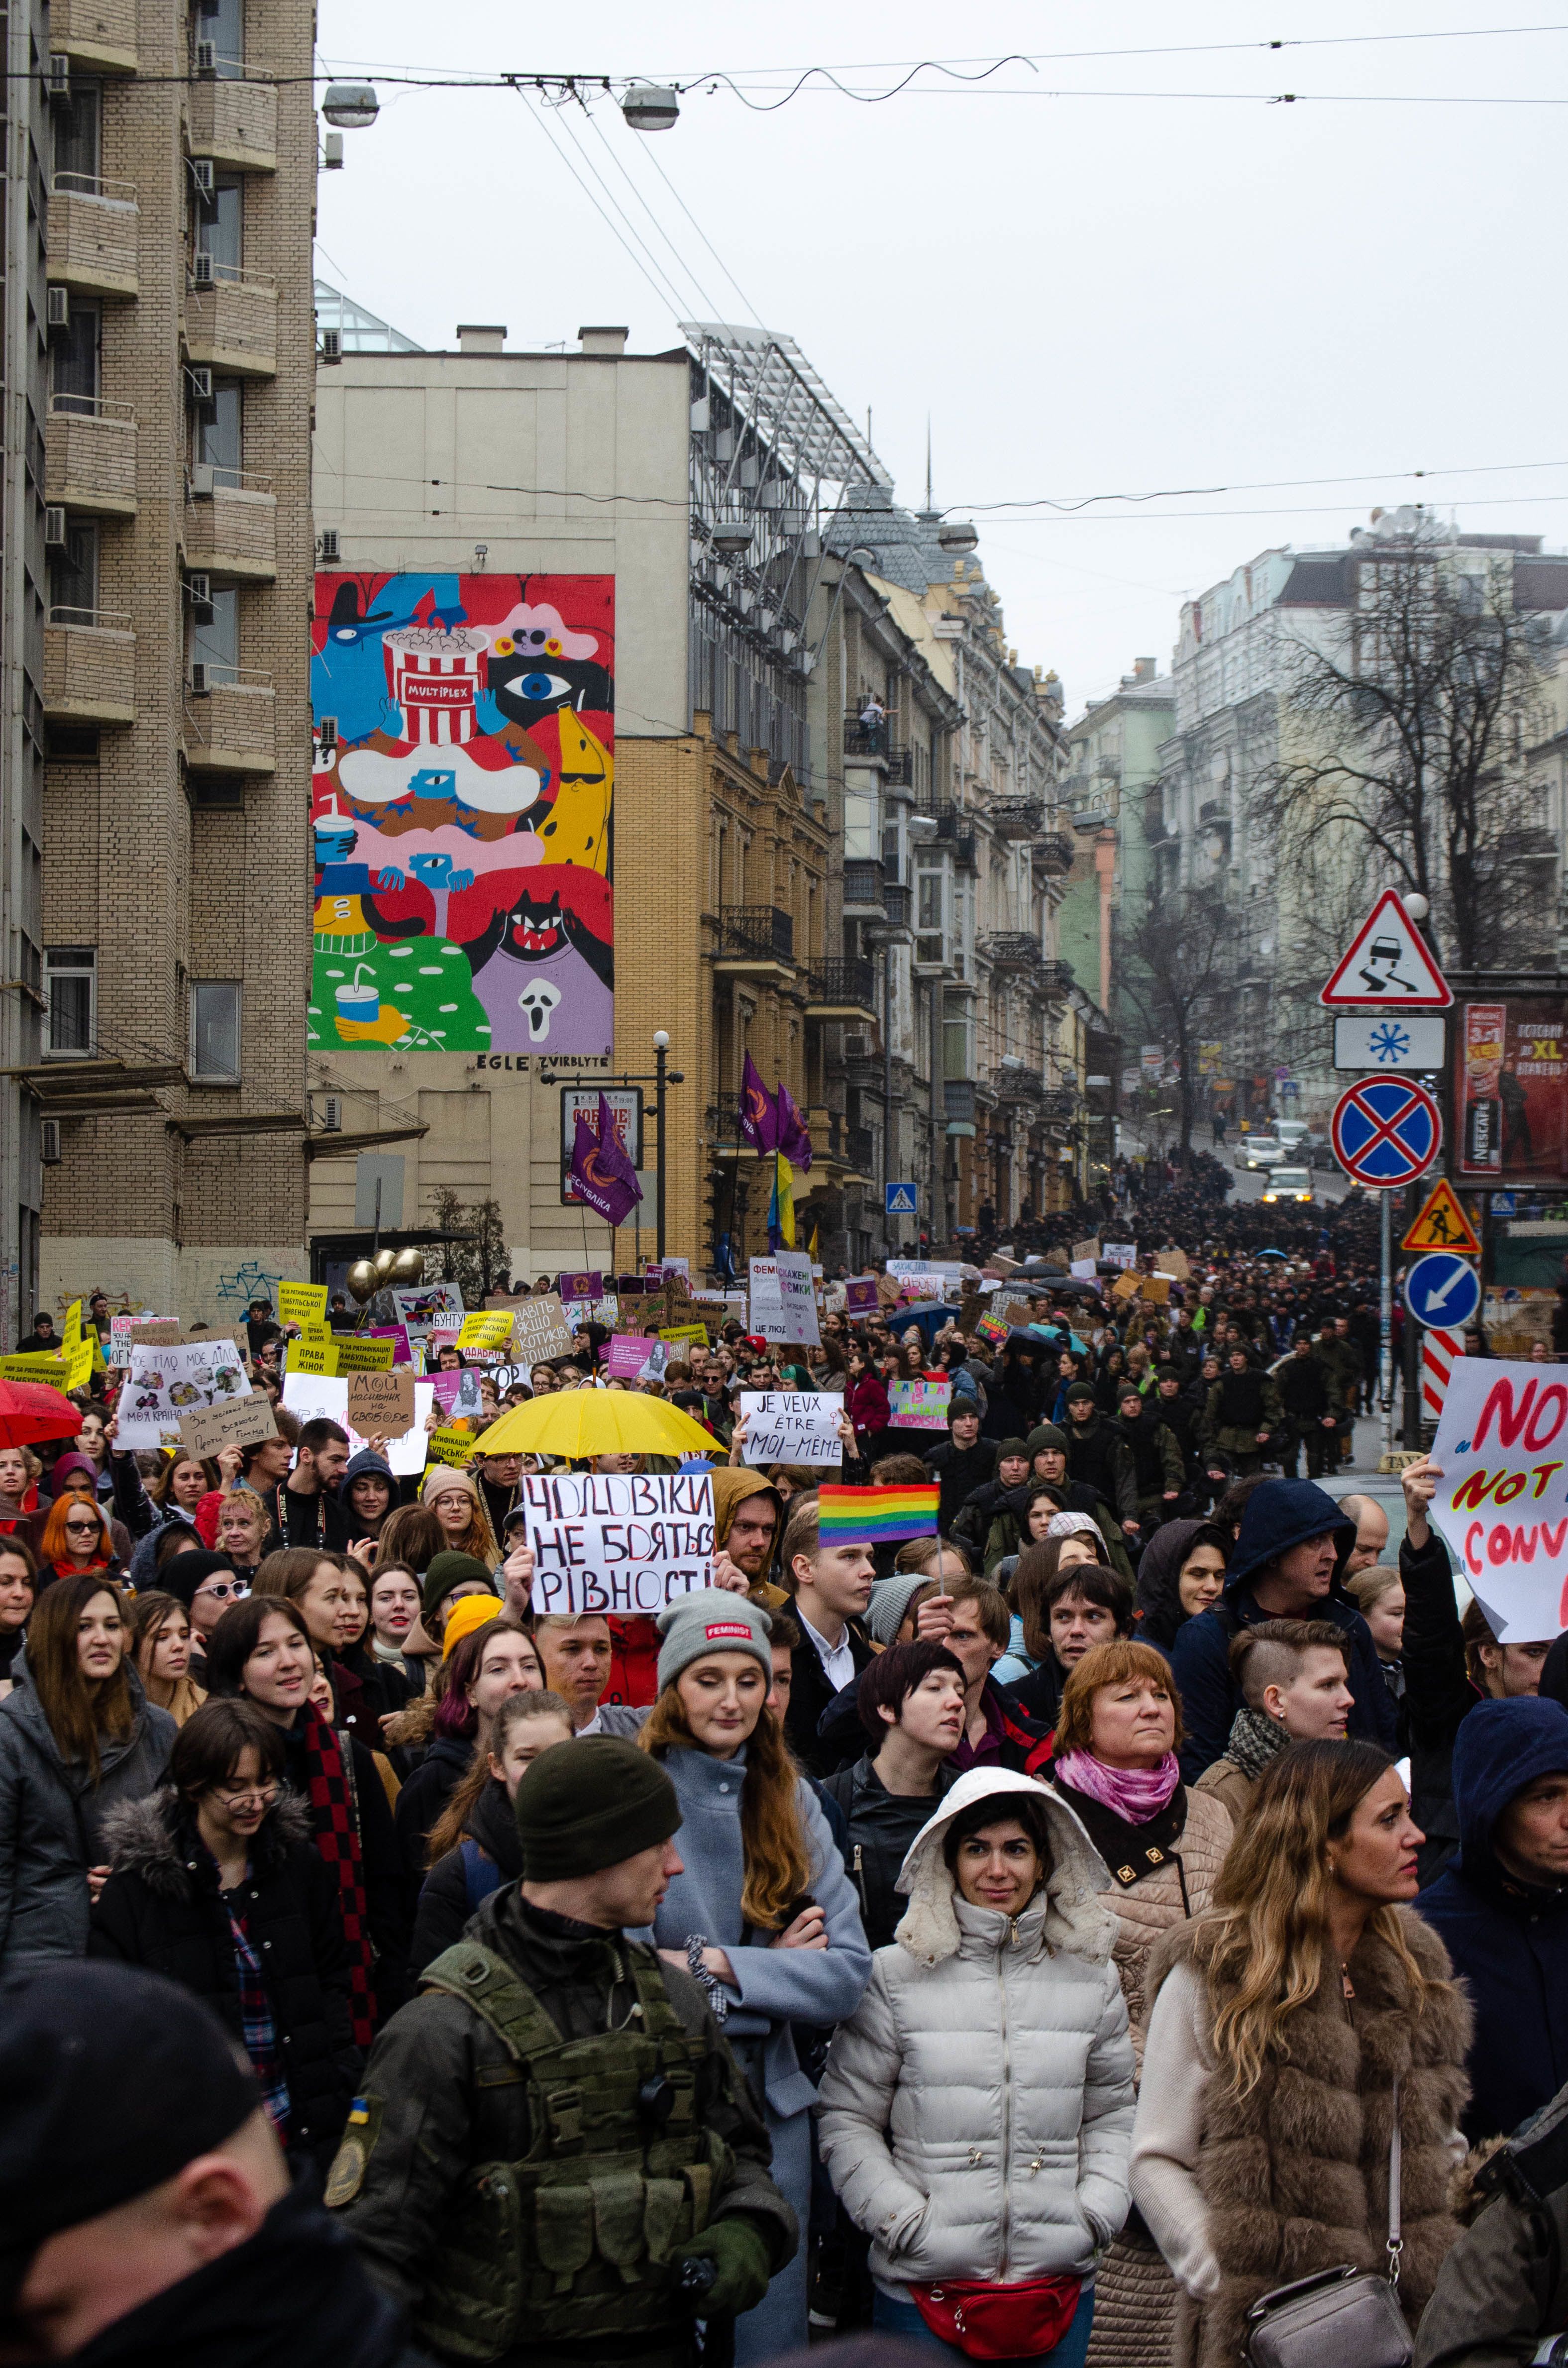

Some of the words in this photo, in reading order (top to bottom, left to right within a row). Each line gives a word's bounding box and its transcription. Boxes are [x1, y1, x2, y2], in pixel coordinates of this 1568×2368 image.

[409, 685, 468, 698] MULTIPLEX
[1532, 1040, 1563, 1059] XL
[477, 1054, 529, 1071] EGLE
[538, 1056, 609, 1069] ZVIRBLYTE
[572, 1096, 580, 1106] 1
[571, 1174, 611, 1213] ЕСПУБЛІКА
[778, 1268, 809, 1281] СКАЖЕНІ
[290, 1290, 323, 1298] РАТИФІКАЦІЮ
[281, 1297, 321, 1308] СТАМБУЛЬСЬКОЇ
[284, 1307, 311, 1318] КОНВЕНЦІЇ
[513, 1300, 555, 1323] НАВІТЬ
[112, 1318, 142, 1333] REB
[434, 1313, 470, 1327] БУНТУ
[517, 1315, 551, 1336] ЯКЩО
[464, 1323, 507, 1333] СТАМБУЛЬСЬКОЇ
[232, 1329, 247, 1345] for
[466, 1333, 496, 1341] КОНВЕНЦІЇ
[112, 1350, 123, 1365] OF
[299, 1349, 324, 1360] ПРАВА
[338, 1352, 388, 1364] ТАМБУЛЬСЬКОЇ
[24, 1368, 66, 1376] РАТИФІКАЦІЮ
[298, 1360, 324, 1372] ЖІНОК
[339, 1362, 378, 1372] КОНВЕНЦІЇ
[354, 1374, 398, 1393] МОЙ
[480, 1365, 520, 1389] TOP
[888, 1381, 945, 1396] FEMINISM
[757, 1395, 775, 1413] JE
[782, 1395, 822, 1412] VEUX
[911, 1393, 924, 1404] IS
[127, 1410, 150, 1422] МОЯ
[153, 1409, 182, 1422] КРАЇНА
[190, 1415, 207, 1429] За
[774, 1413, 816, 1431] ÊTRE
[430, 1435, 470, 1447] АТИФІКАЦІЮ
[749, 1432, 841, 1458] MOI-MÊME
[1451, 1461, 1565, 1512] NOT
[525, 1475, 713, 1521] ЧОЛОВІКИ
[533, 1524, 587, 1568] НЕ
[601, 1521, 717, 1563] БОЯТЬСЯ
[540, 1562, 713, 1614] РІВНОСТІ
[707, 1625, 750, 1636] FEMINIST
